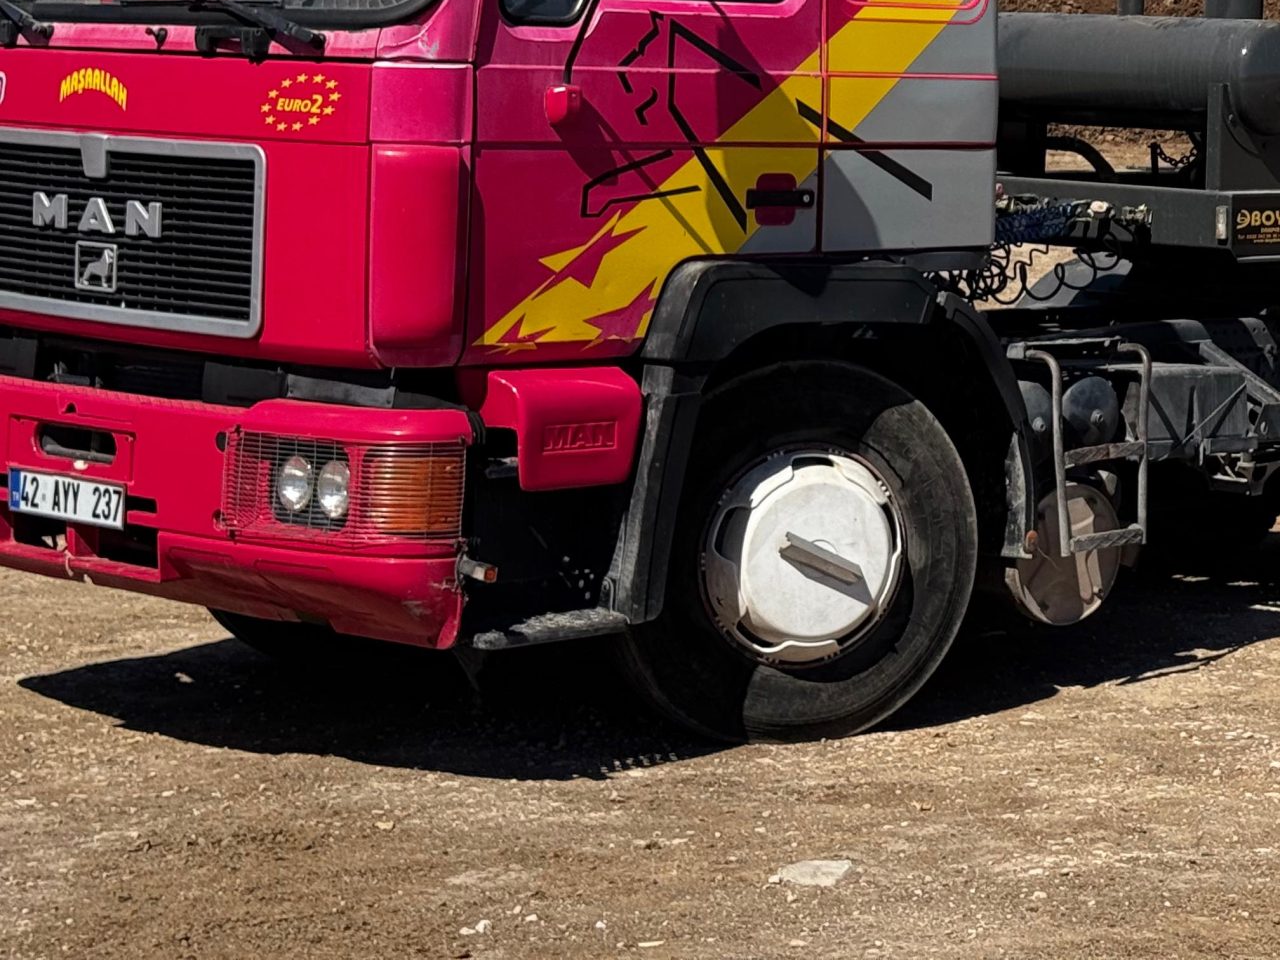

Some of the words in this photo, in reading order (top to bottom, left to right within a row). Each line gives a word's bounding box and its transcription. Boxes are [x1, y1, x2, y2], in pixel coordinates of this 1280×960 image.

[59, 67, 127, 112] MAŞAALLAH
[276, 94, 323, 114] EURO2
[32, 191, 162, 238] MAN
[543, 424, 615, 449] MAN
[21, 474, 39, 509] 42
[52, 478, 80, 515] AYY
[92, 486, 122, 522] 237
